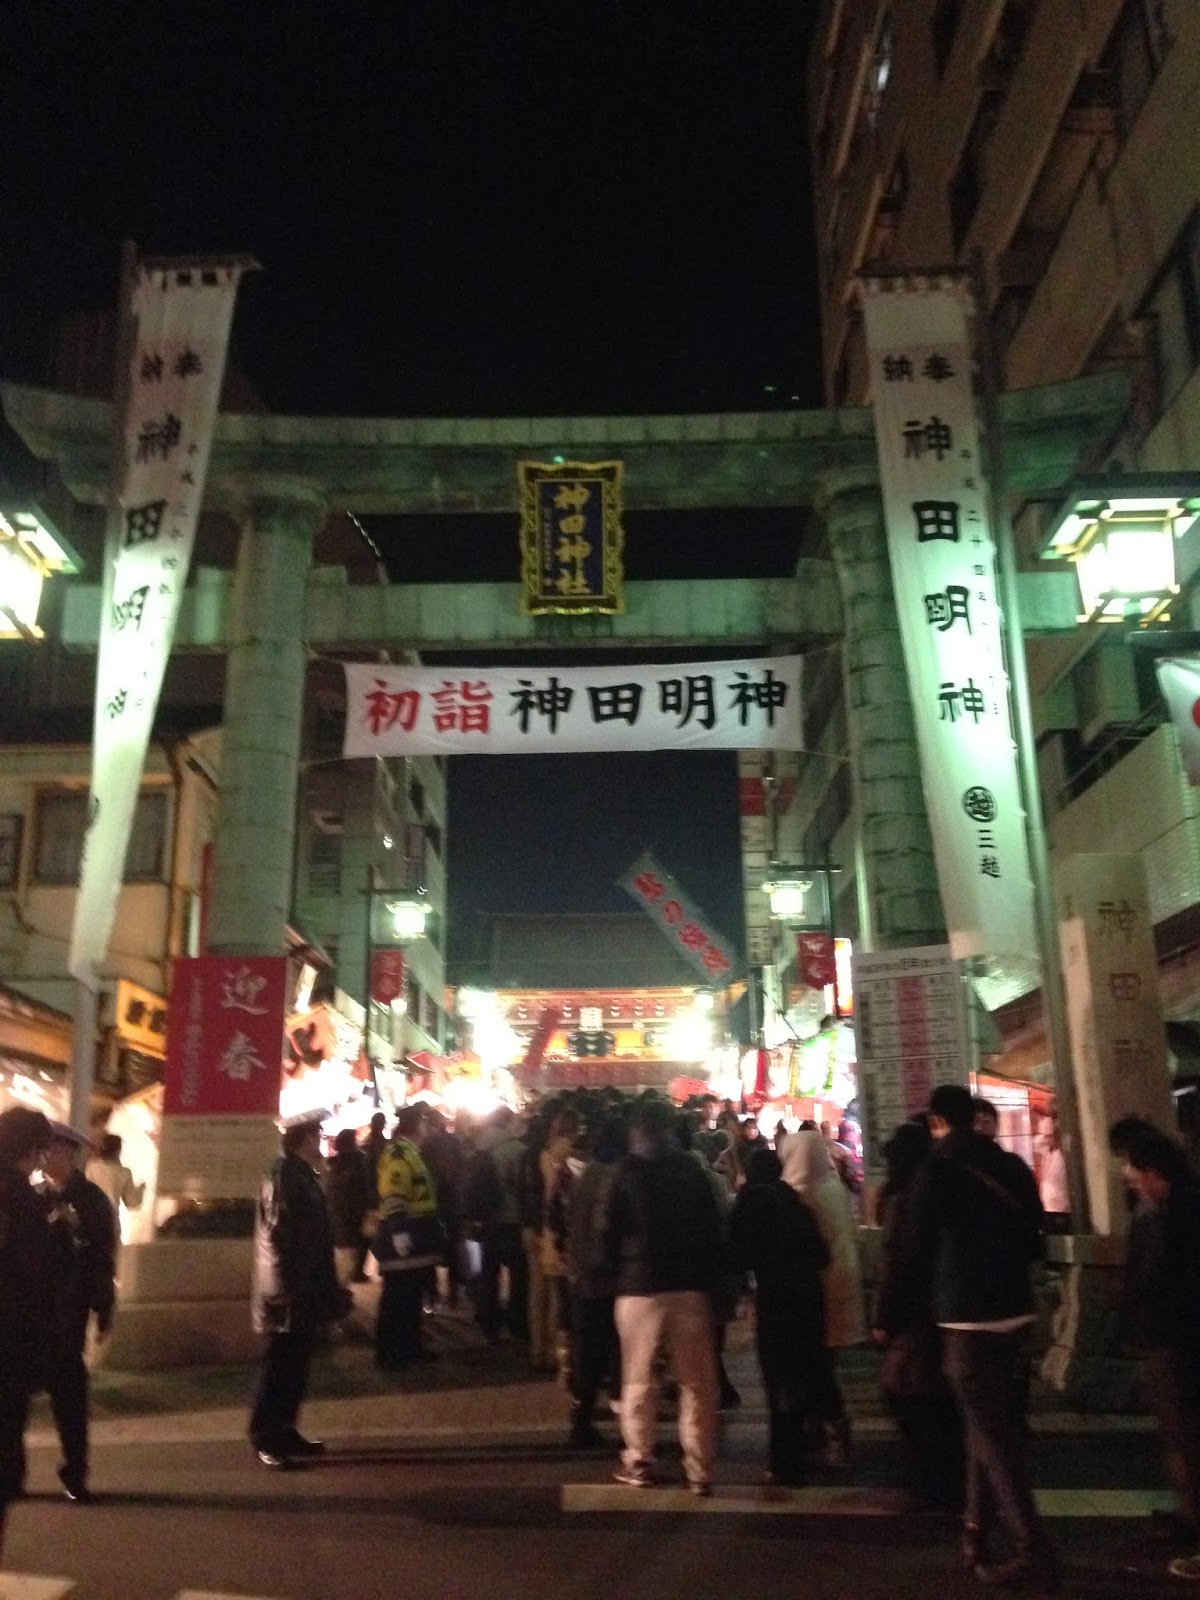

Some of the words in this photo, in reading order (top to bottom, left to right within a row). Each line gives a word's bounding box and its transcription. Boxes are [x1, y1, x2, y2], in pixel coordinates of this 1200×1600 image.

[903, 416, 985, 724] 神田明神
[218, 965, 270, 1081] 迎春
